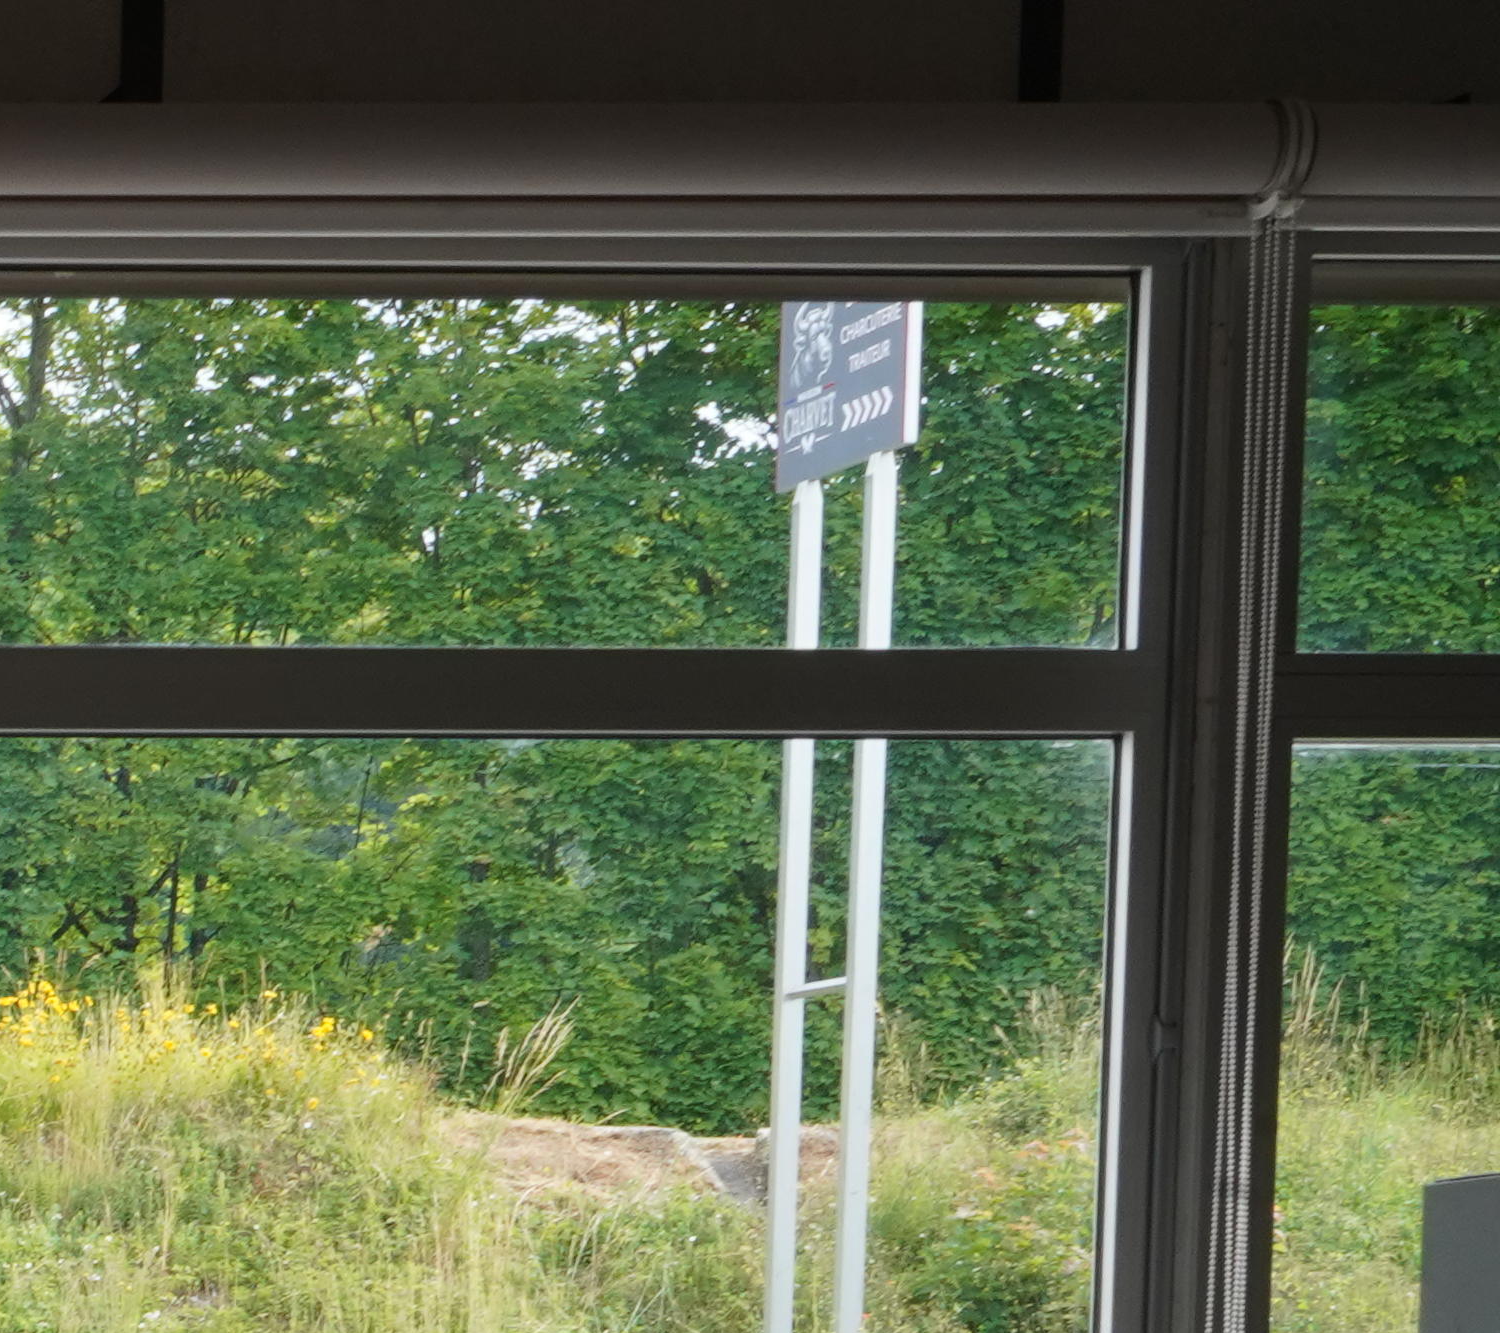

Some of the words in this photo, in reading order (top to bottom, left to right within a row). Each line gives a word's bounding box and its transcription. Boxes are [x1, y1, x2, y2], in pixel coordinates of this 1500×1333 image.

[840, 302, 903, 345] CHARCUTERIE
[848, 338, 891, 373] TRAITEUR
[783, 391, 837, 444] CHARVET
